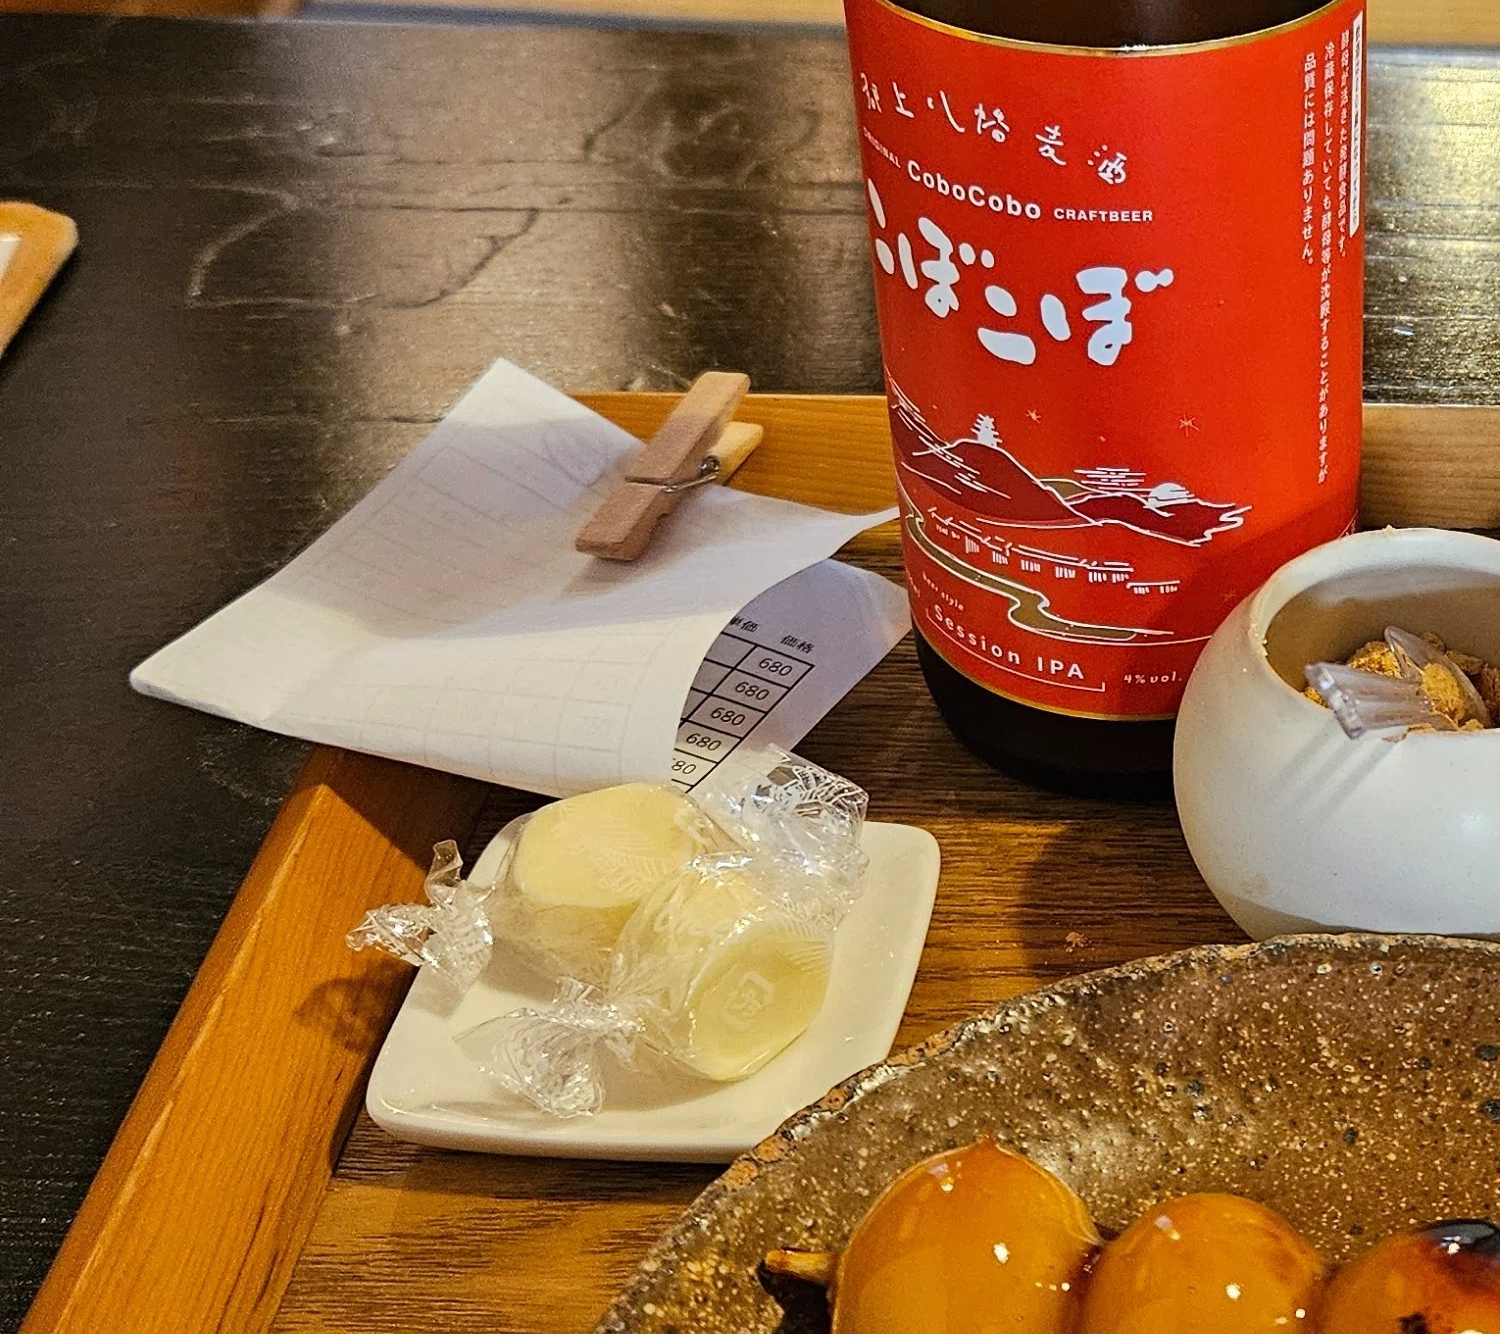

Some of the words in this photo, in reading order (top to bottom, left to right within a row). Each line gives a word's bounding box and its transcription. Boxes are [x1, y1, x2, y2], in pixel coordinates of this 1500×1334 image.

[1301, 51, 1316, 265] 品質には問題ありません。
[907, 160, 1042, 220] CoboCobo
[1053, 207, 1154, 223] CRAFTBEER
[868, 178, 1174, 366] こぼこぼ
[940, 591, 965, 612] style
[780, 634, 815, 654] 価格
[933, 603, 1021, 665] Session
[1037, 655, 1085, 680] IPA
[758, 657, 793, 677] 680
[734, 680, 770, 702] 680
[710, 707, 746, 726] 680
[685, 732, 722, 751] 680
[671, 757, 697, 775] 80
